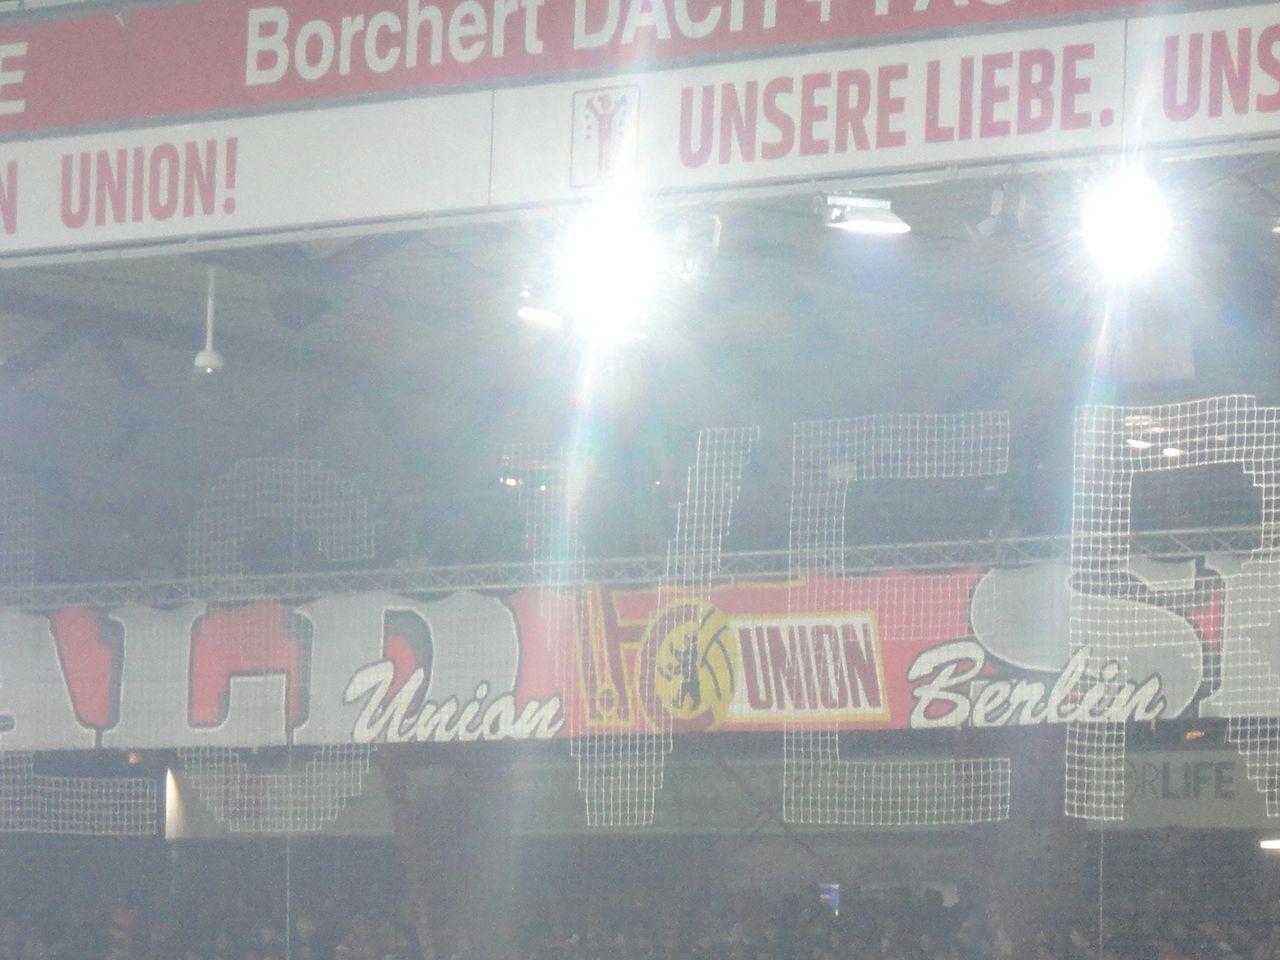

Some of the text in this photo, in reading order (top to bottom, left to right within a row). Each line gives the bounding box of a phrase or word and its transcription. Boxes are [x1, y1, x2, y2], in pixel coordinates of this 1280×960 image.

[244, 0, 546, 87] Borchert
[678, 62, 906, 169] UNSERE
[923, 42, 1115, 144] LIEBE.
[61, 137, 238, 229] UNION!
[344, 660, 566, 743] Union
[737, 622, 882, 711] UNION
[904, 645, 1166, 730] Berlin
